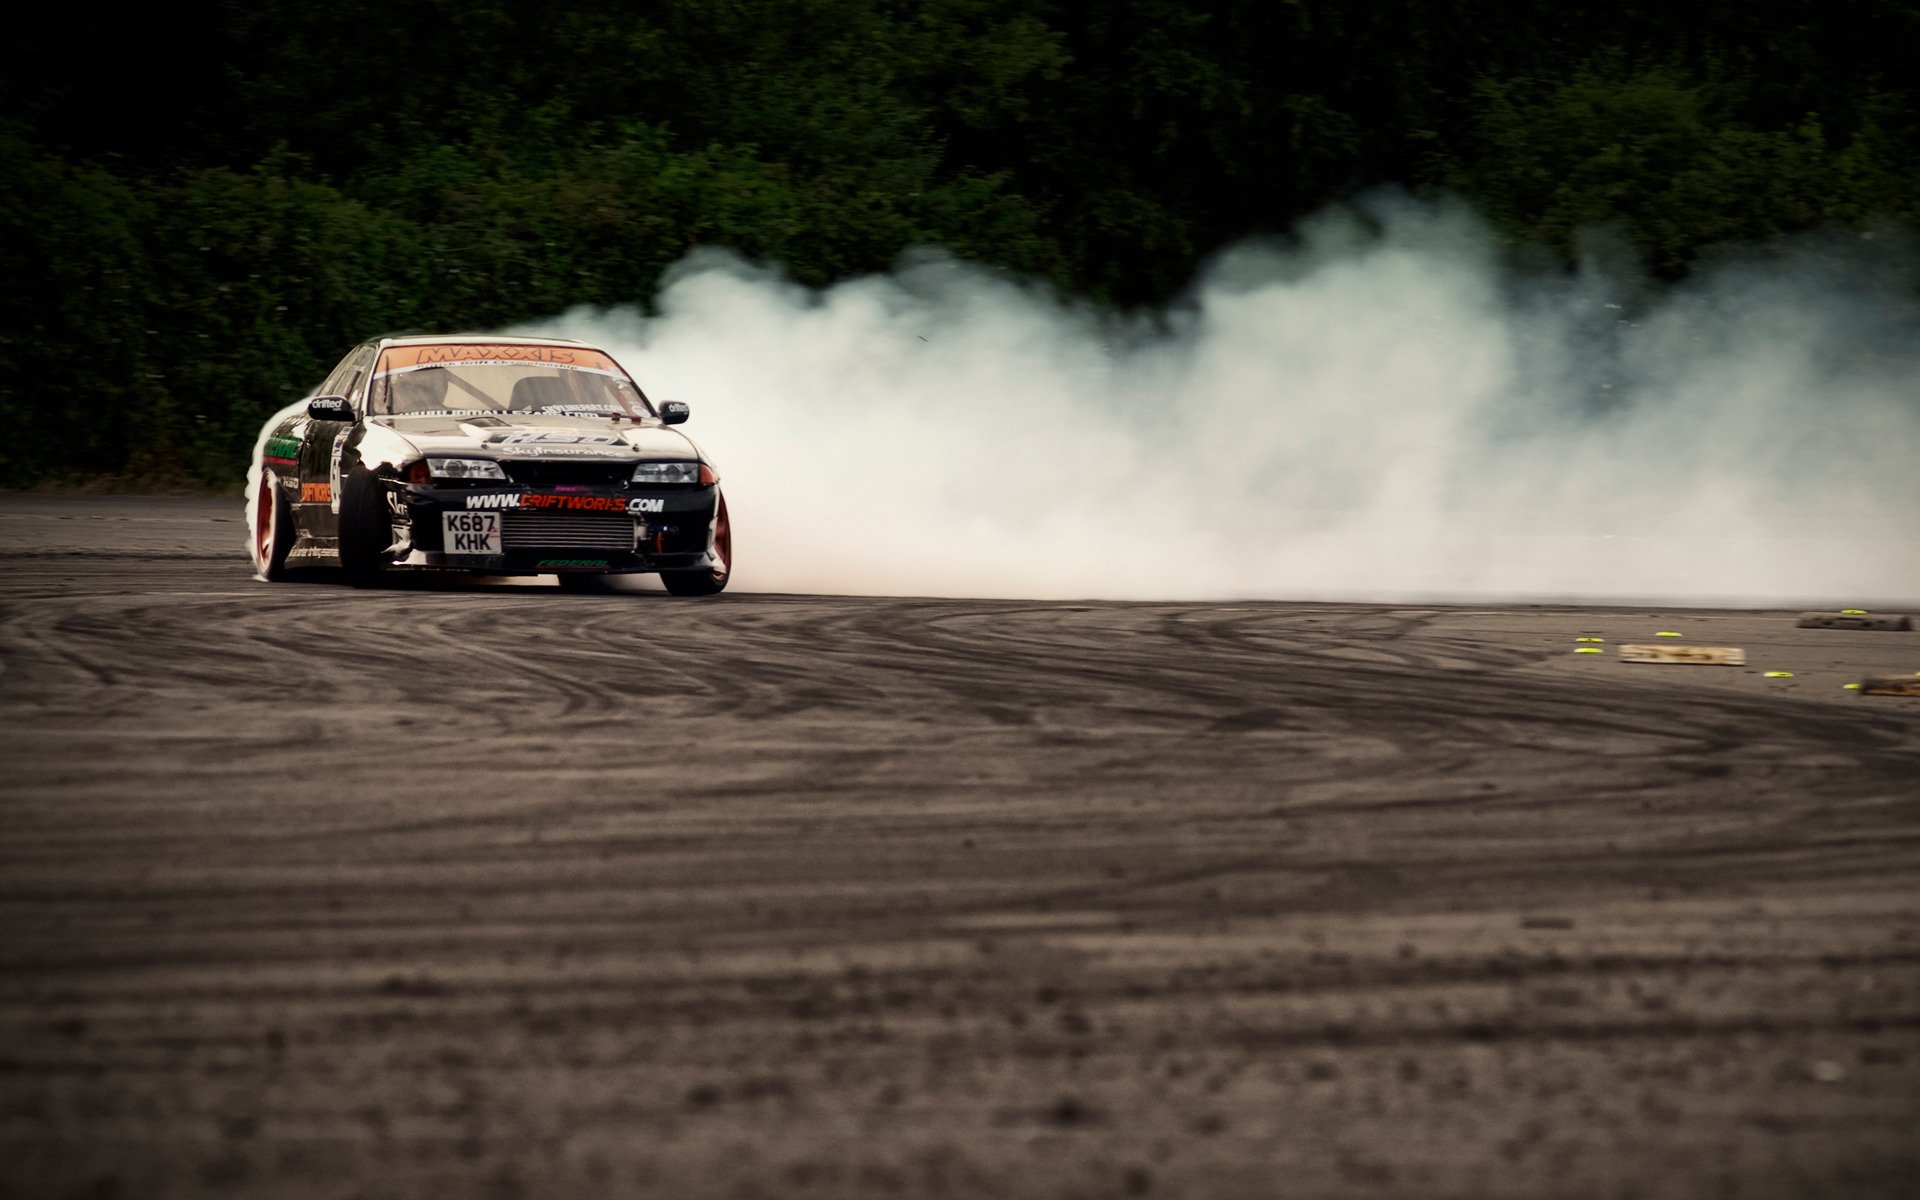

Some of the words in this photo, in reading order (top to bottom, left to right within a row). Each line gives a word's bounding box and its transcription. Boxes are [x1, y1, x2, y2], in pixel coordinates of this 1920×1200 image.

[416, 346, 575, 364] MAXXIS
[311, 399, 342, 409] drifted
[447, 514, 495, 532] K687
[454, 533, 492, 550] KHK
